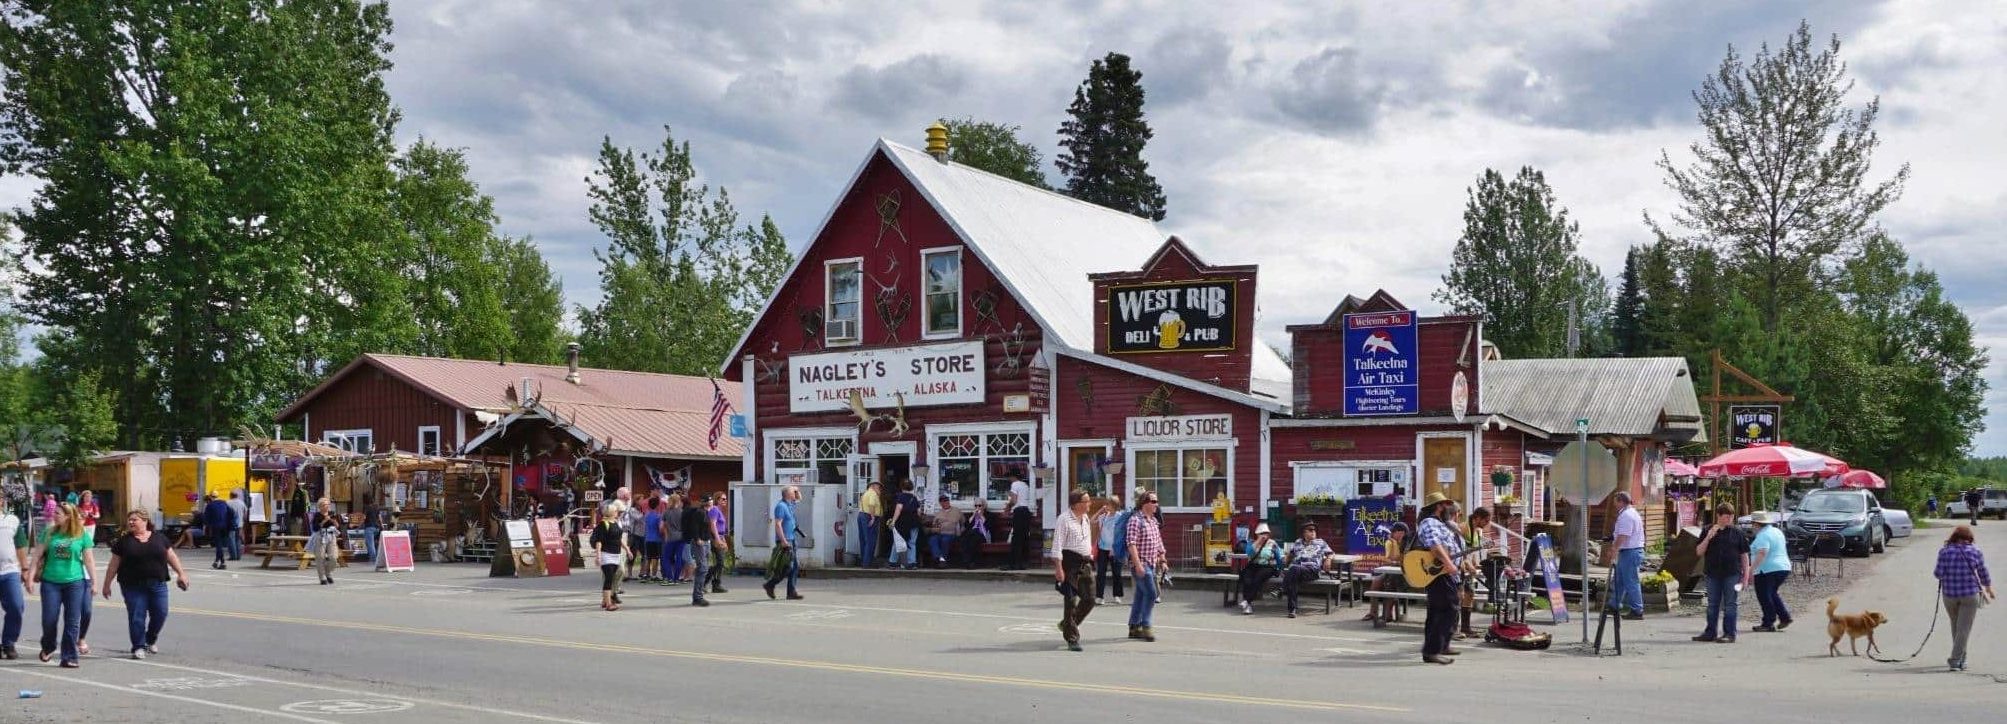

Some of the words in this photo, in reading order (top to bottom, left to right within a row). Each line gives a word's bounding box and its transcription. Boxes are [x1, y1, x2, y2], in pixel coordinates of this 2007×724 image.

[1118, 289, 1181, 322] WEST
[1186, 287, 1226, 318] RIB
[1125, 330, 1150, 343] DELI
[1184, 333, 1191, 341] &
[1194, 328, 1219, 341] PUB
[800, 359, 886, 384] NAGLEY'S
[911, 354, 975, 376] STORE
[1354, 357, 1408, 370] Talkeetna
[1358, 373, 1375, 384] Air
[1379, 371, 1404, 384] Taxi
[914, 382, 957, 396] ALASKA
[1365, 387, 1395, 396] McKinley
[1134, 420, 1180, 436] LIQUOR
[1186, 418, 1228, 435] STORE
[1736, 414, 1757, 426] WEST
[1759, 414, 1773, 426] RIB
[1741, 465, 1771, 474] Coca-Cola
[1349, 506, 1399, 522] Talkeetna
